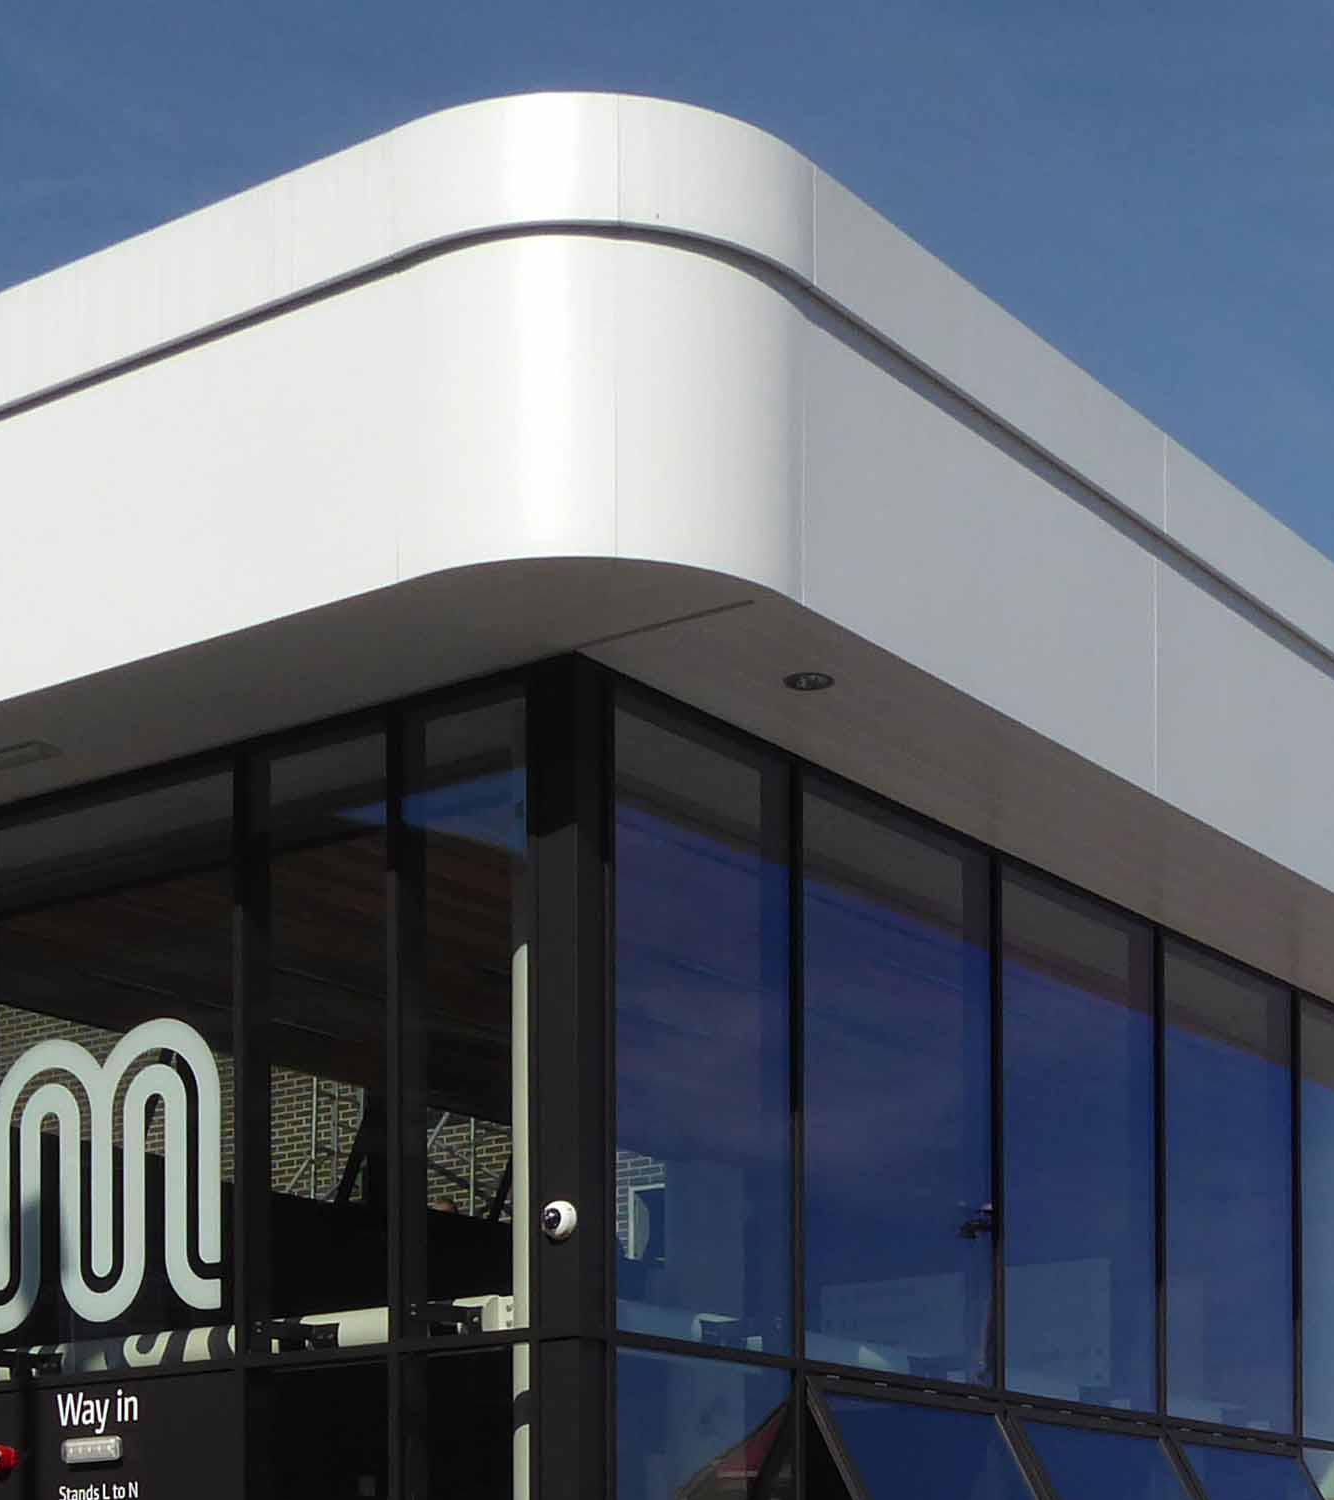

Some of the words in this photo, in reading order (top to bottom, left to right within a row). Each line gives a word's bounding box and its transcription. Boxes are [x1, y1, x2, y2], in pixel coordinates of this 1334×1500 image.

[57, 1392, 109, 1434] Way
[116, 1389, 138, 1422] in
[103, 1484, 110, 1499] L
[113, 1484, 125, 1499] to
[128, 1481, 138, 1498] N
